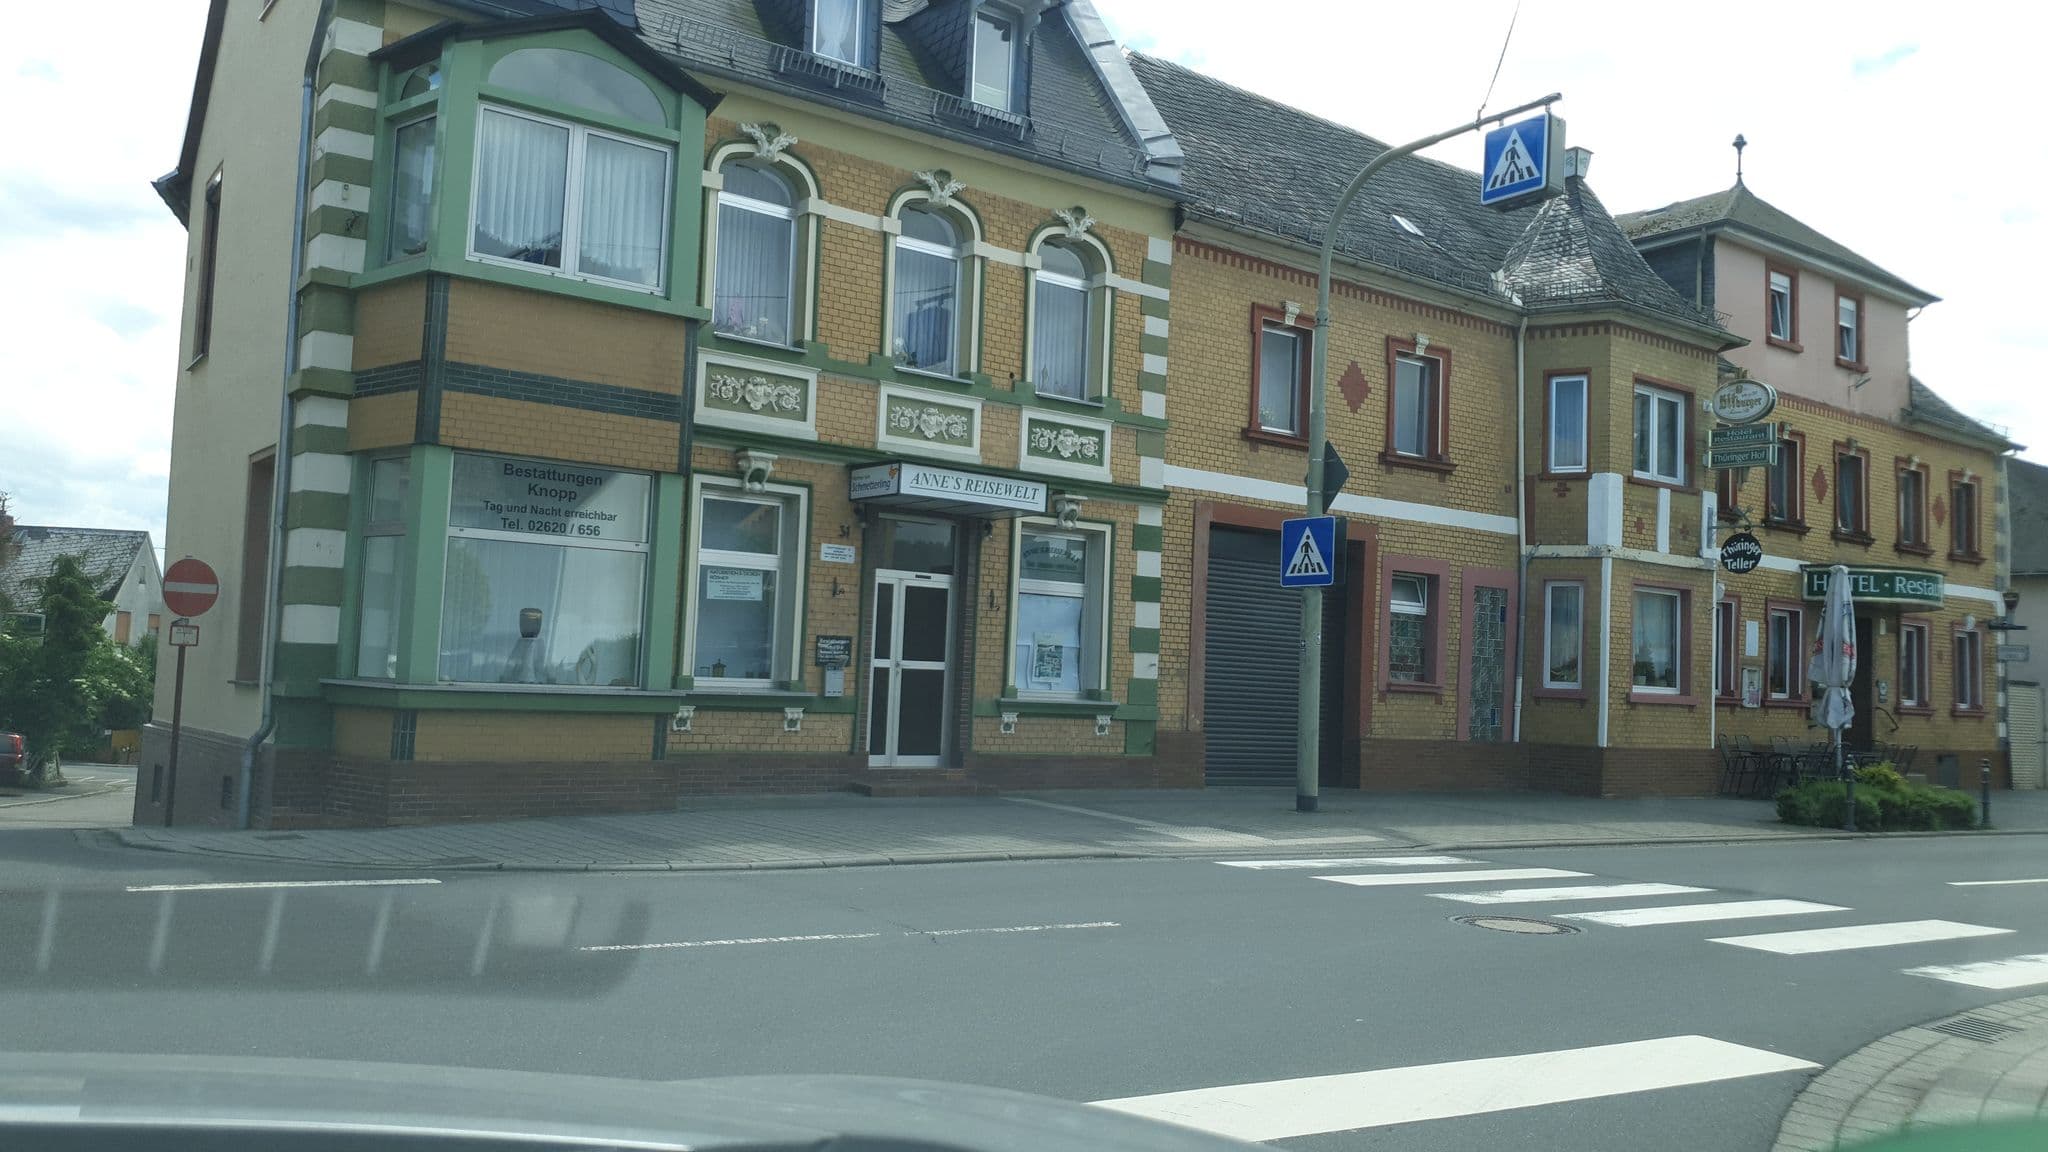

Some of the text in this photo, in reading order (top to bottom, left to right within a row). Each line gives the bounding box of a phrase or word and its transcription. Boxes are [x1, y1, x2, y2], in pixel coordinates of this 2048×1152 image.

[1727, 429, 1752, 437] Hotel
[1750, 450, 1766, 460] Hof
[503, 463, 603, 486] Bestattungen
[528, 483, 577, 502] Knopp
[964, 478, 1040, 500] REISEWELT
[484, 500, 618, 522] Tag und Nacht erreichbar
[501, 517, 524, 531] Tel.
[528, 520, 567, 534] 02620
[578, 524, 601, 537] 656
[1721, 538, 1762, 558] Thüringer
[1724, 557, 1756, 570] Teller
[1812, 574, 1880, 593] HTEL
